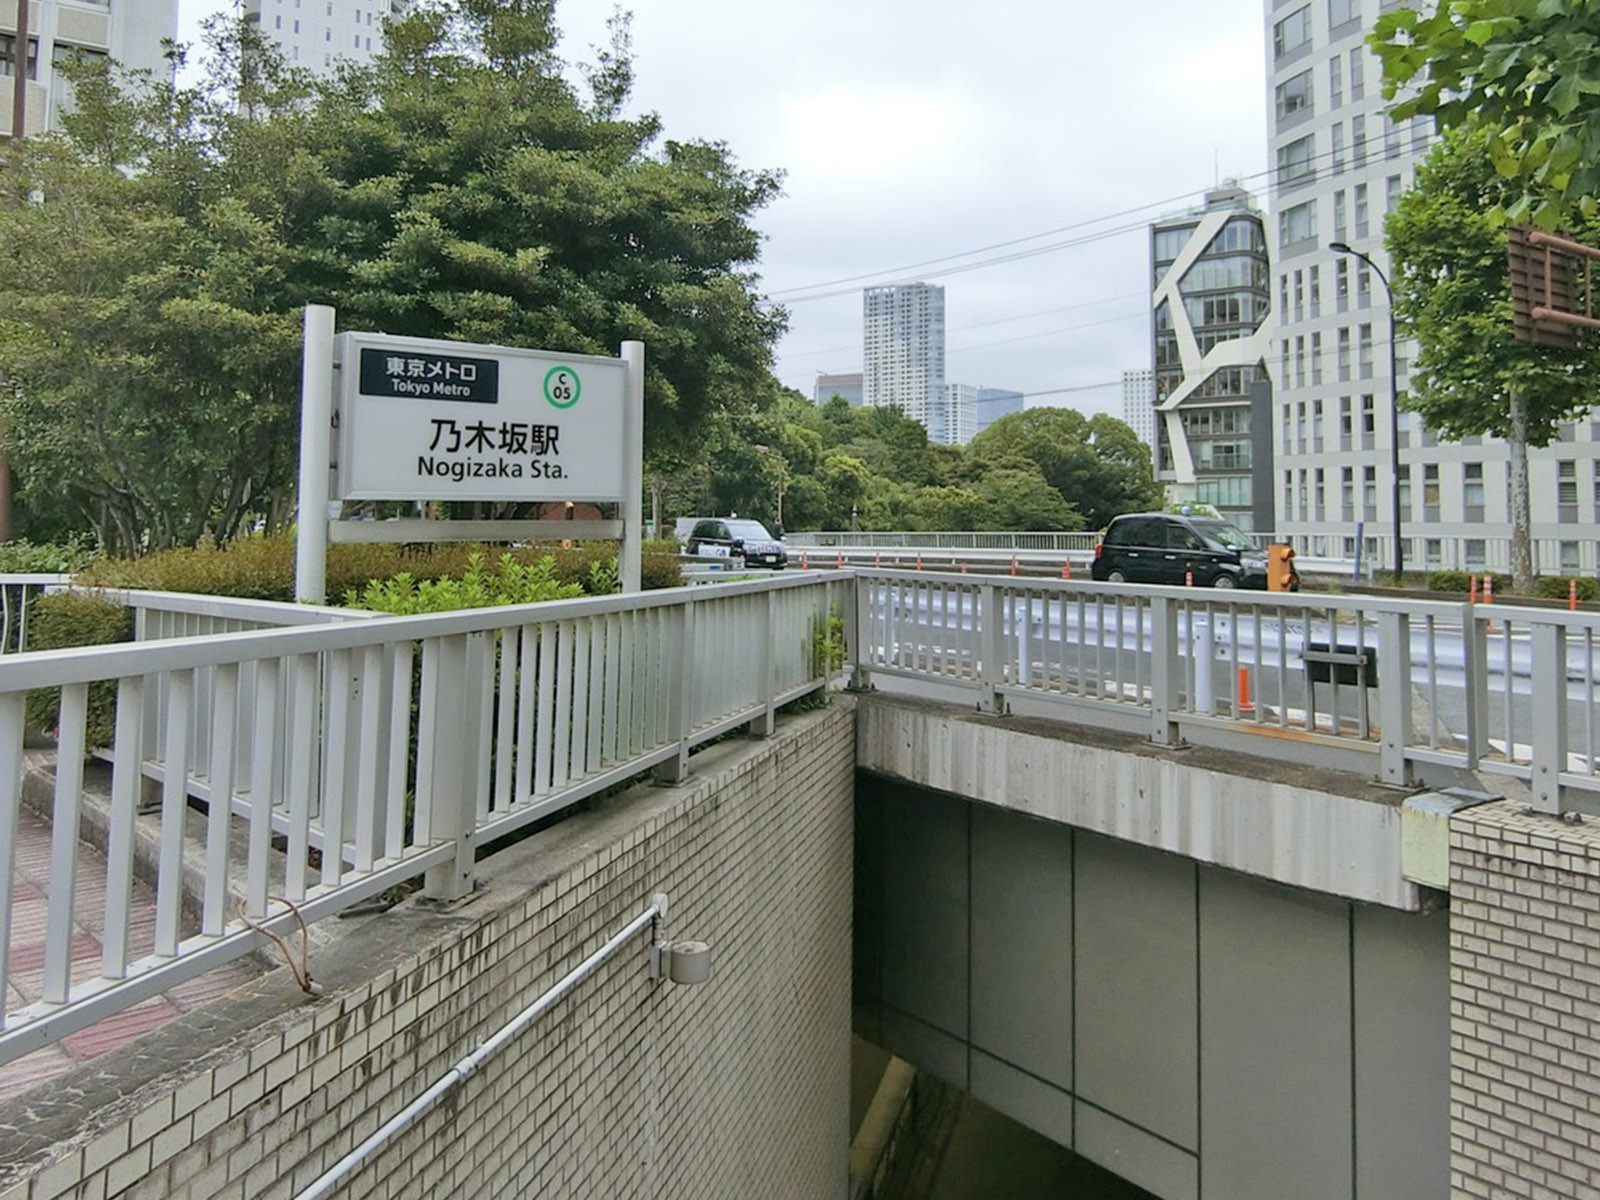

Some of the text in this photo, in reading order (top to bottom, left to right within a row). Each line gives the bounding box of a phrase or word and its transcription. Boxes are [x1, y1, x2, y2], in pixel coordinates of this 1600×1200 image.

[386, 357, 476, 381] 東京メトロ
[558, 373, 567, 385] C
[391, 378, 471, 397] Tokyo Metro
[553, 386, 571, 400] 05
[429, 419, 559, 456] 乃木坂駅
[418, 456, 569, 482] Nogizaka Sta.
